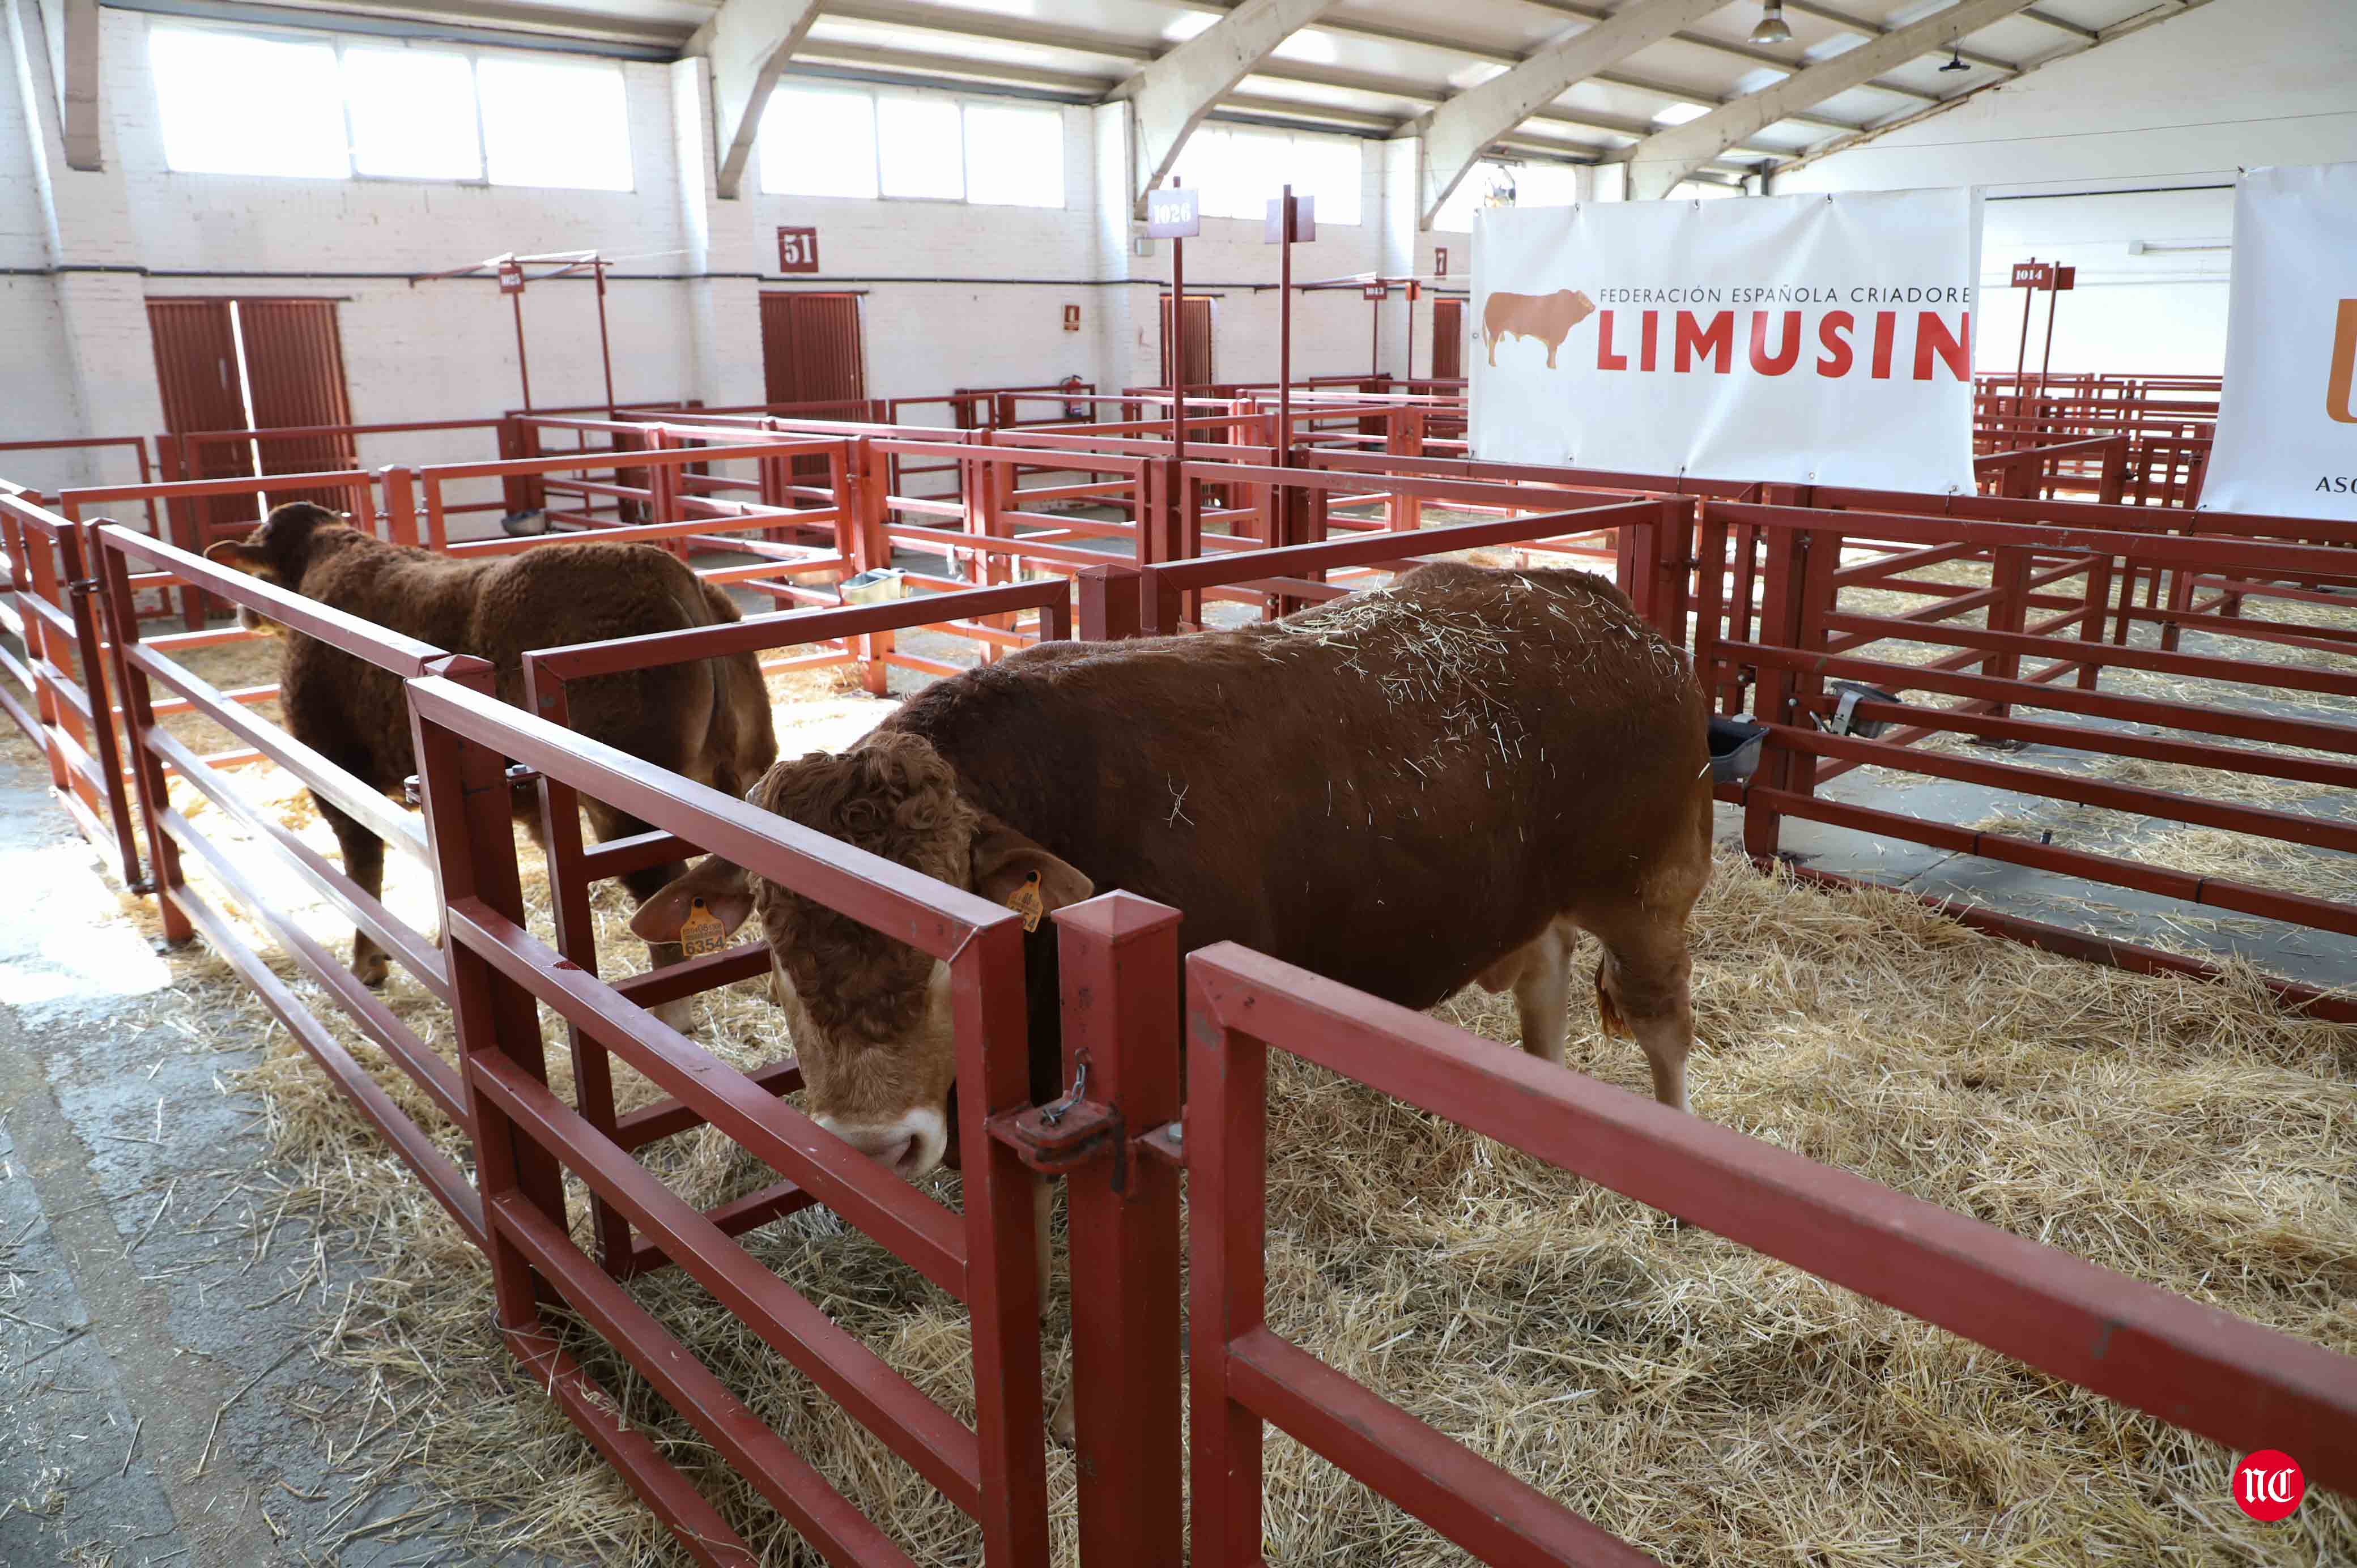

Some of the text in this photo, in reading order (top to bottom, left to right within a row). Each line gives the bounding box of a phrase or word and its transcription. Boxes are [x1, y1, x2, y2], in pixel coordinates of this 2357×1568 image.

[1152, 202, 1191, 224] 1026
[784, 234, 814, 263] 51
[2015, 269, 2043, 281] 1014
[1600, 285, 1721, 302] FEDERACIÓN
[1731, 284, 1838, 303] ESPAÑOLA
[1597, 309, 1971, 382] LIMUSIN
[685, 936, 726, 956] 6354
